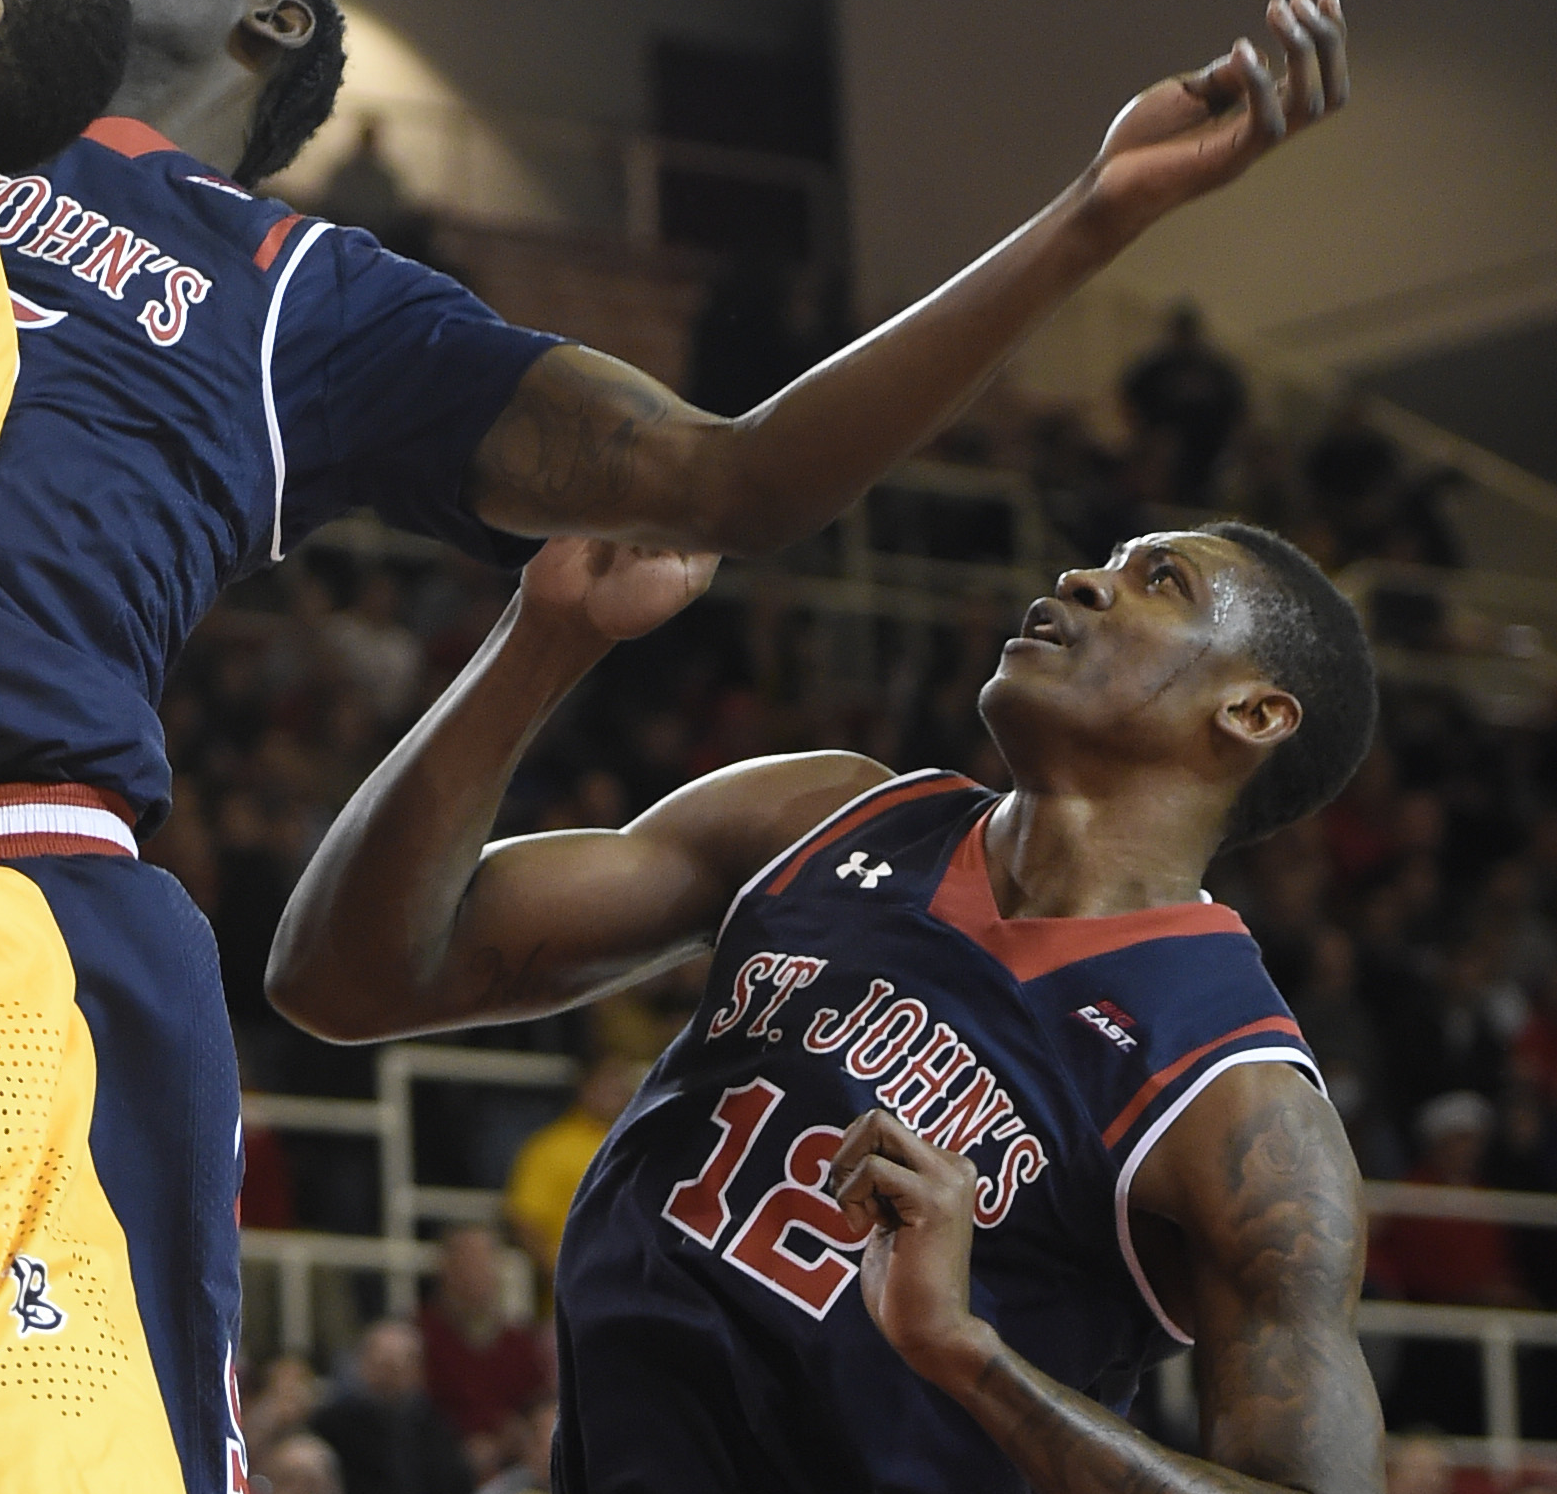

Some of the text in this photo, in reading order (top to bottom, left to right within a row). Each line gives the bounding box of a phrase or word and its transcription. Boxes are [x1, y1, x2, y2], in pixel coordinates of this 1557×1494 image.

[705, 951, 1050, 1229] ST. JOHN'S
[1076, 1005, 1138, 1046] EAST
[660, 1076, 876, 1322] 12
